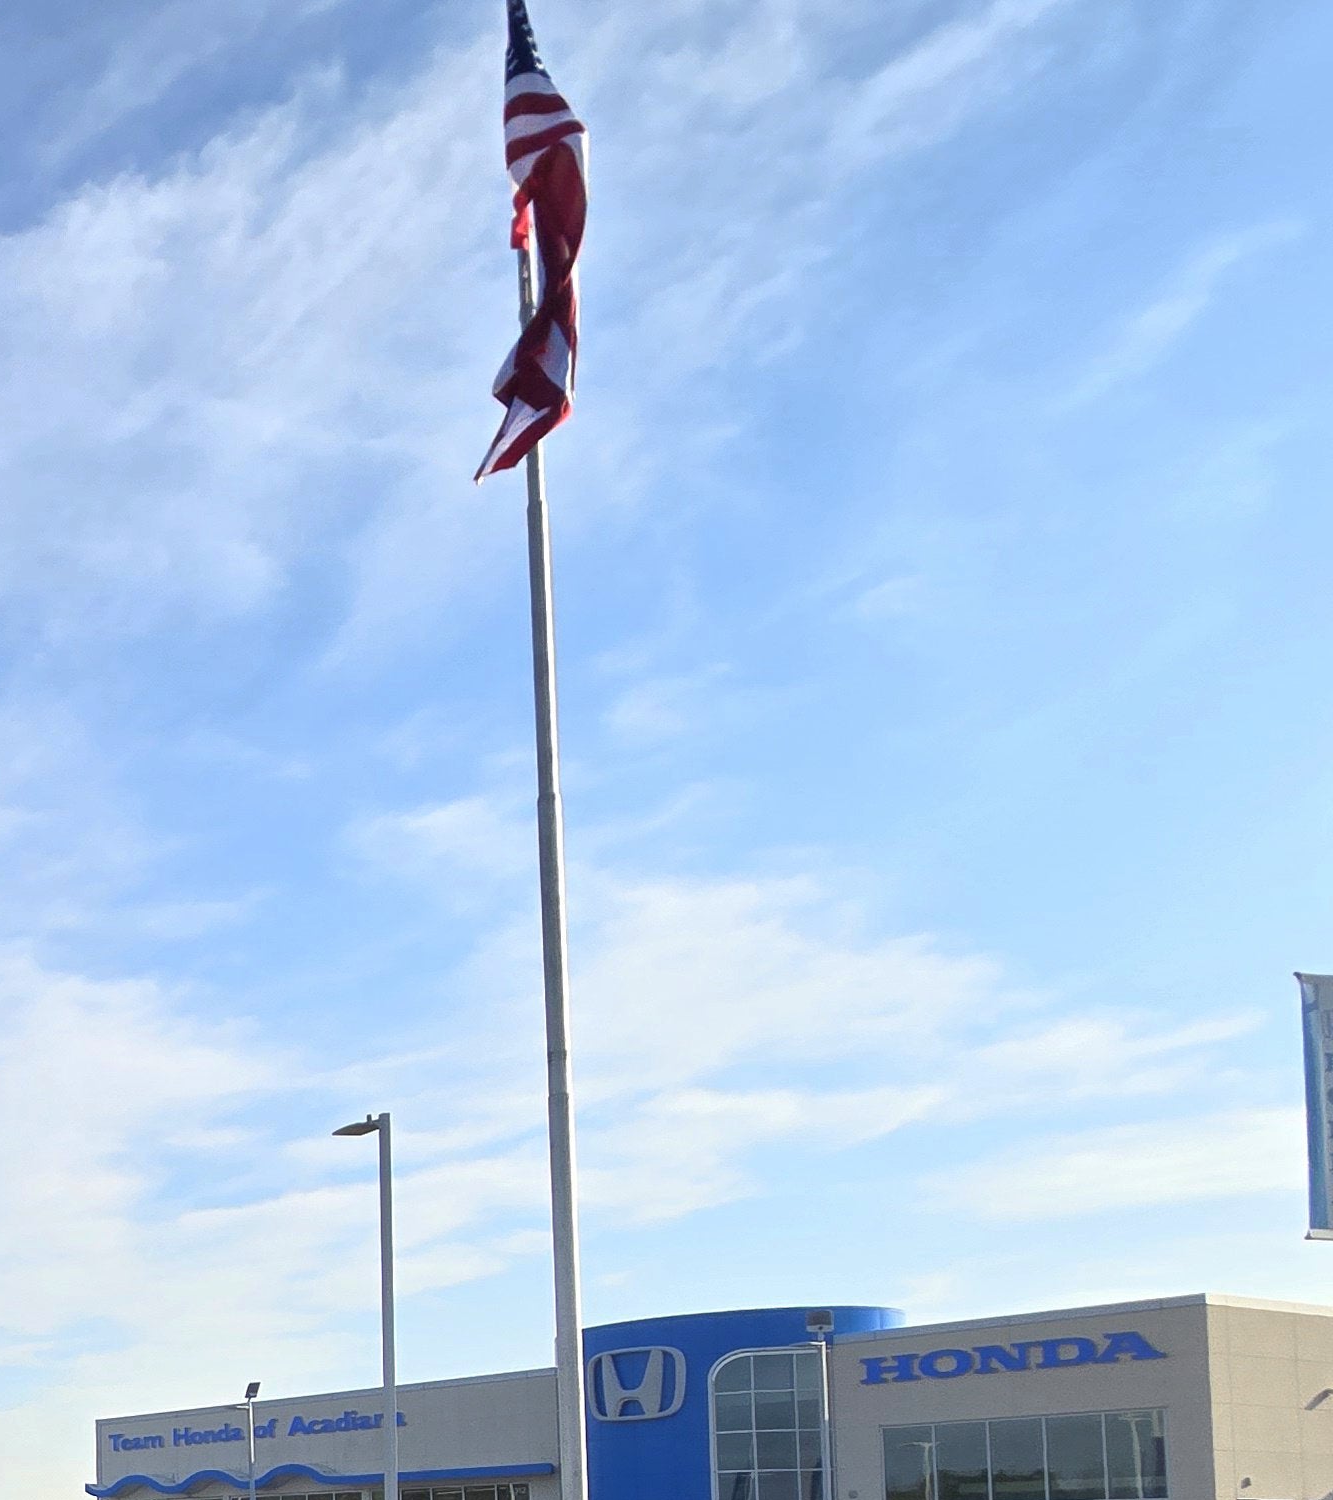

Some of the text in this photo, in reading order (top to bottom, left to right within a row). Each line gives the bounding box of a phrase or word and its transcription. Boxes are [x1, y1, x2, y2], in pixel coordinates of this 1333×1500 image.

[859, 1331, 1167, 1385] HONDA
[108, 1433, 165, 1452] Team
[172, 1423, 245, 1447] Honda
[253, 1418, 278, 1438] of
